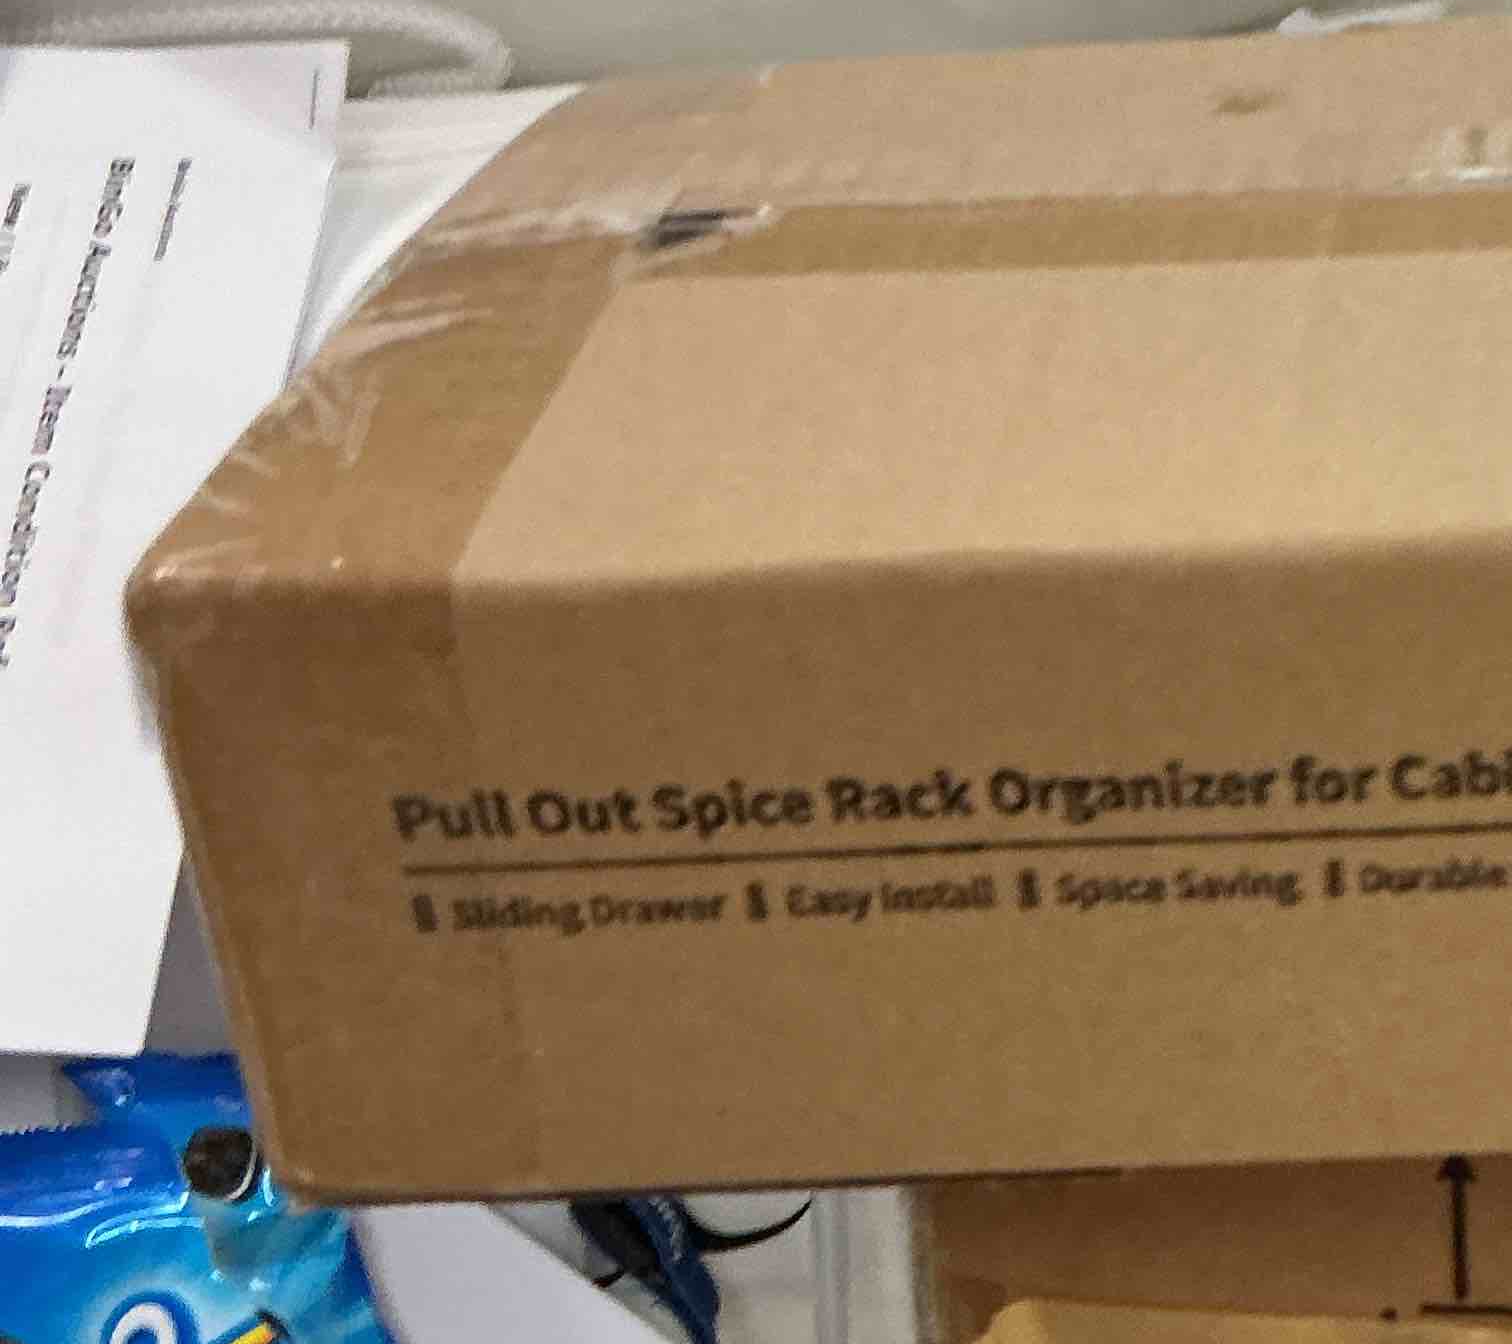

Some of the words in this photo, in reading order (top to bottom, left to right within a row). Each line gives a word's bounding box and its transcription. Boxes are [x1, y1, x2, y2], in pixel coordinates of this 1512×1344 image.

[393, 788, 516, 840] Pull
[527, 786, 640, 834] Out
[652, 778, 815, 838] Spice
[825, 768, 975, 822] Rack
[990, 758, 1277, 826] Organizer
[1291, 753, 1376, 804] for
[451, 896, 586, 936] Sliding
[589, 894, 725, 924] Drawer
[785, 886, 872, 922] Easy
[1055, 873, 1167, 911] Space
[1174, 866, 1302, 906] Saving
[1359, 859, 1507, 894] Durable
